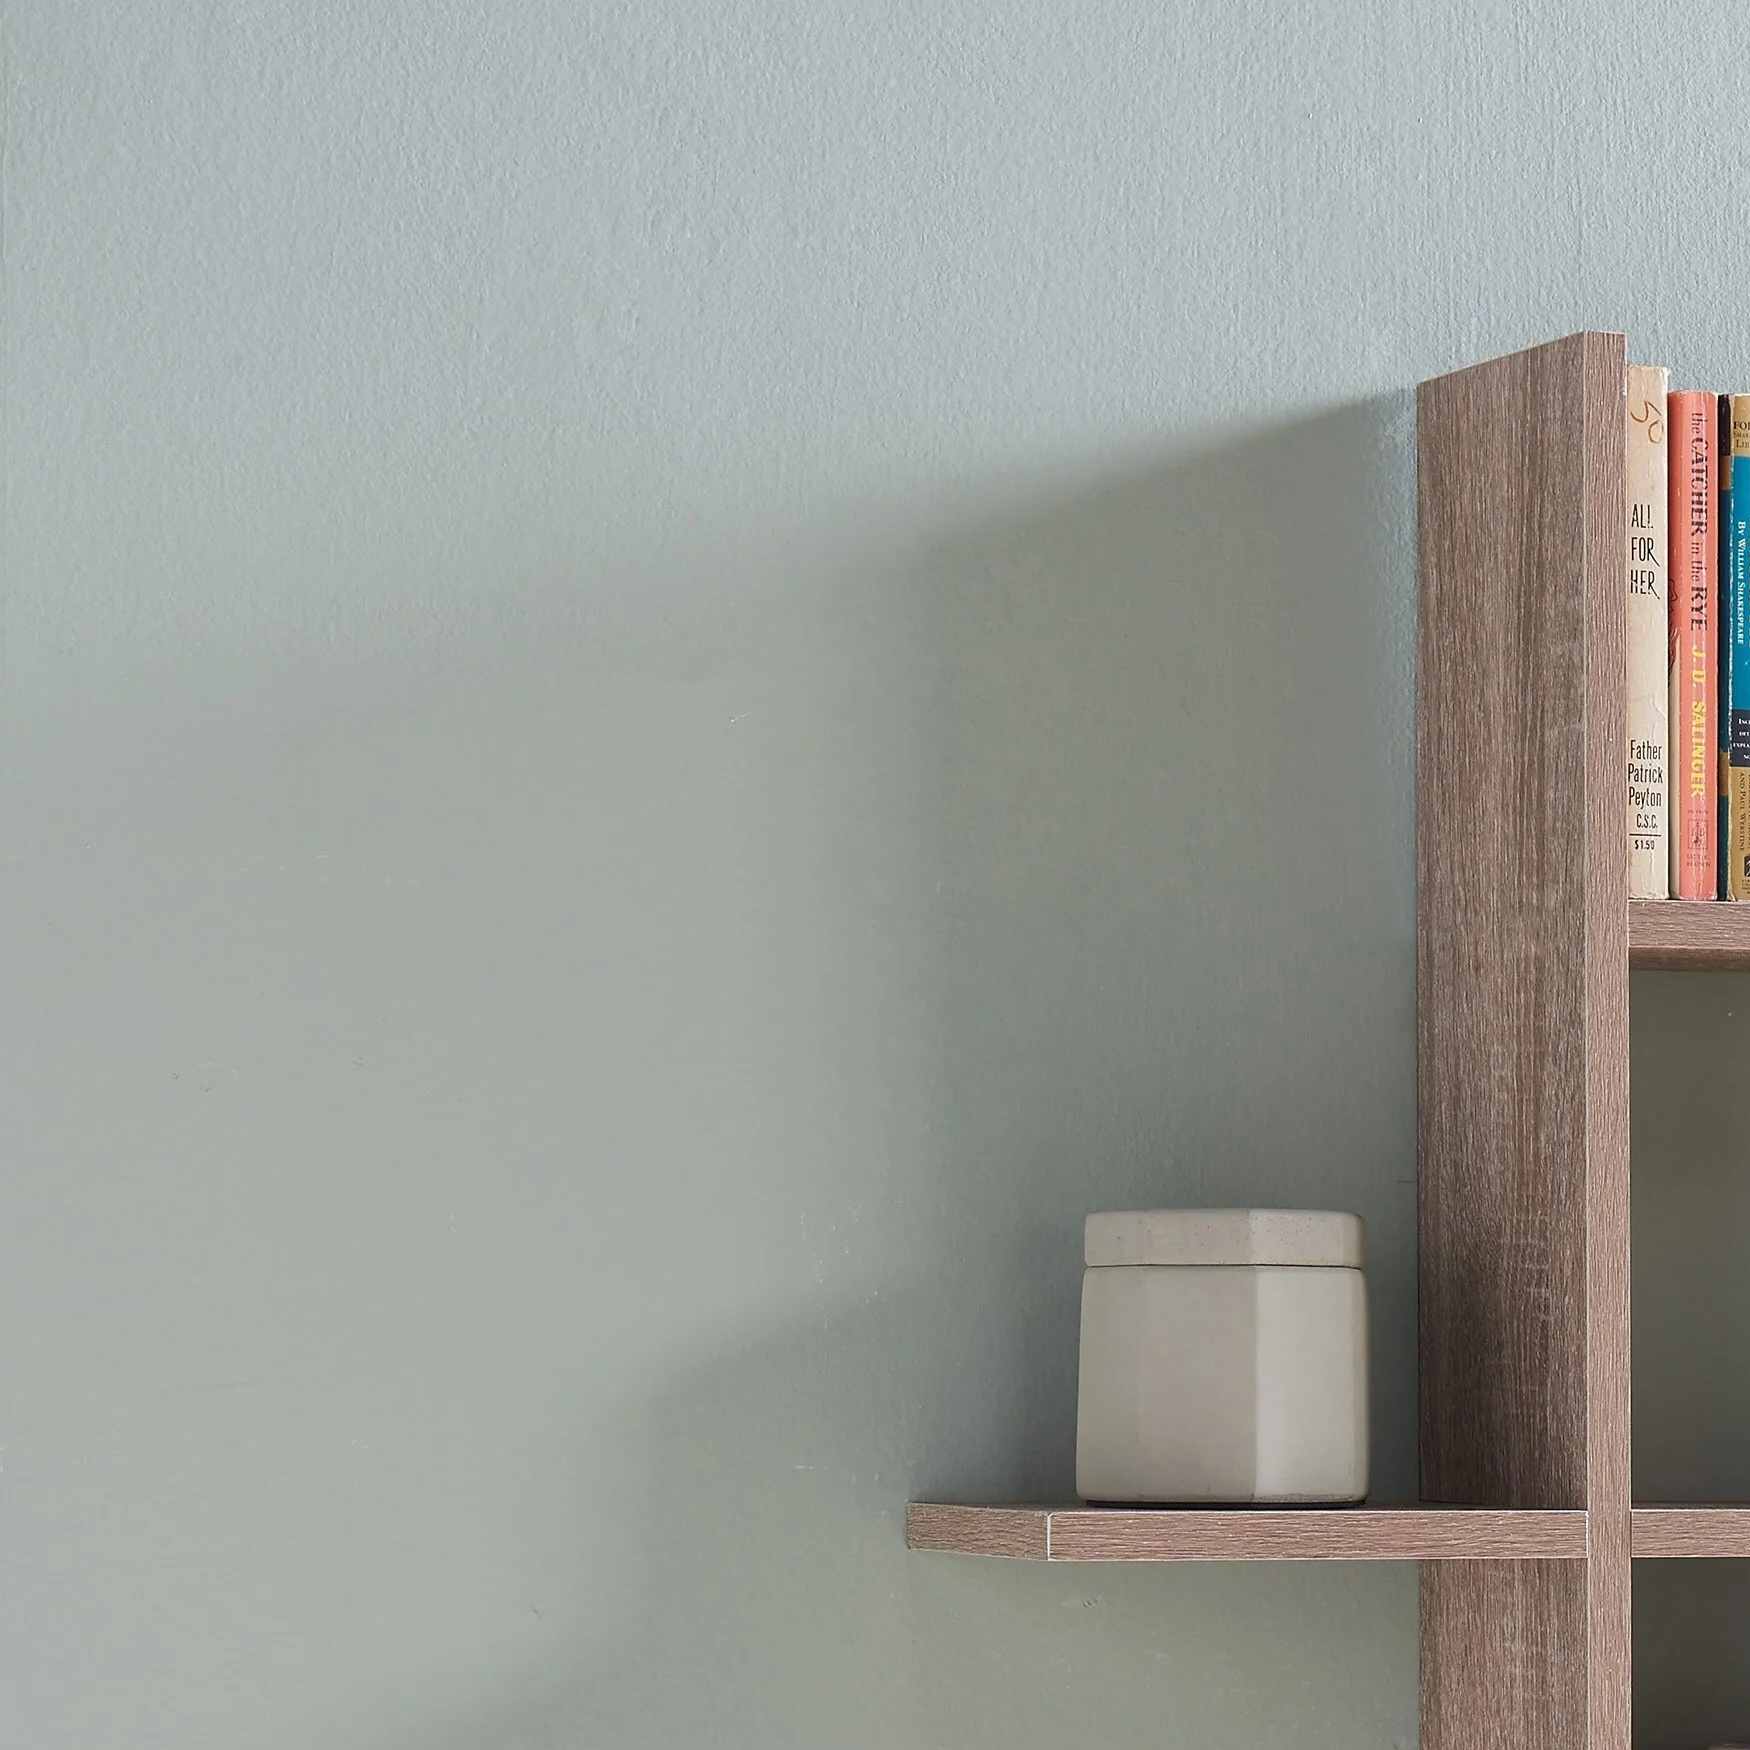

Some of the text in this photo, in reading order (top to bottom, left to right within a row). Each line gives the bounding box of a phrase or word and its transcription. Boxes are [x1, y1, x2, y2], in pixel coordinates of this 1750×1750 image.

[1631, 503, 1654, 529] ALL
[1690, 412, 1709, 631] the CATCHER in the RYE
[1631, 536, 1660, 567] FOR
[1630, 569, 1660, 600] HER
[1691, 645, 1706, 662] J.
[1691, 669, 1707, 688] D.
[1630, 739, 1662, 760] Father
[1691, 700, 1708, 800] SALINGER
[1628, 763, 1663, 784] Patrick
[1628, 786, 1662, 810] Peyton
[1636, 813, 1658, 829] C.S.C.
[1634, 839, 1655, 850] $1.50
